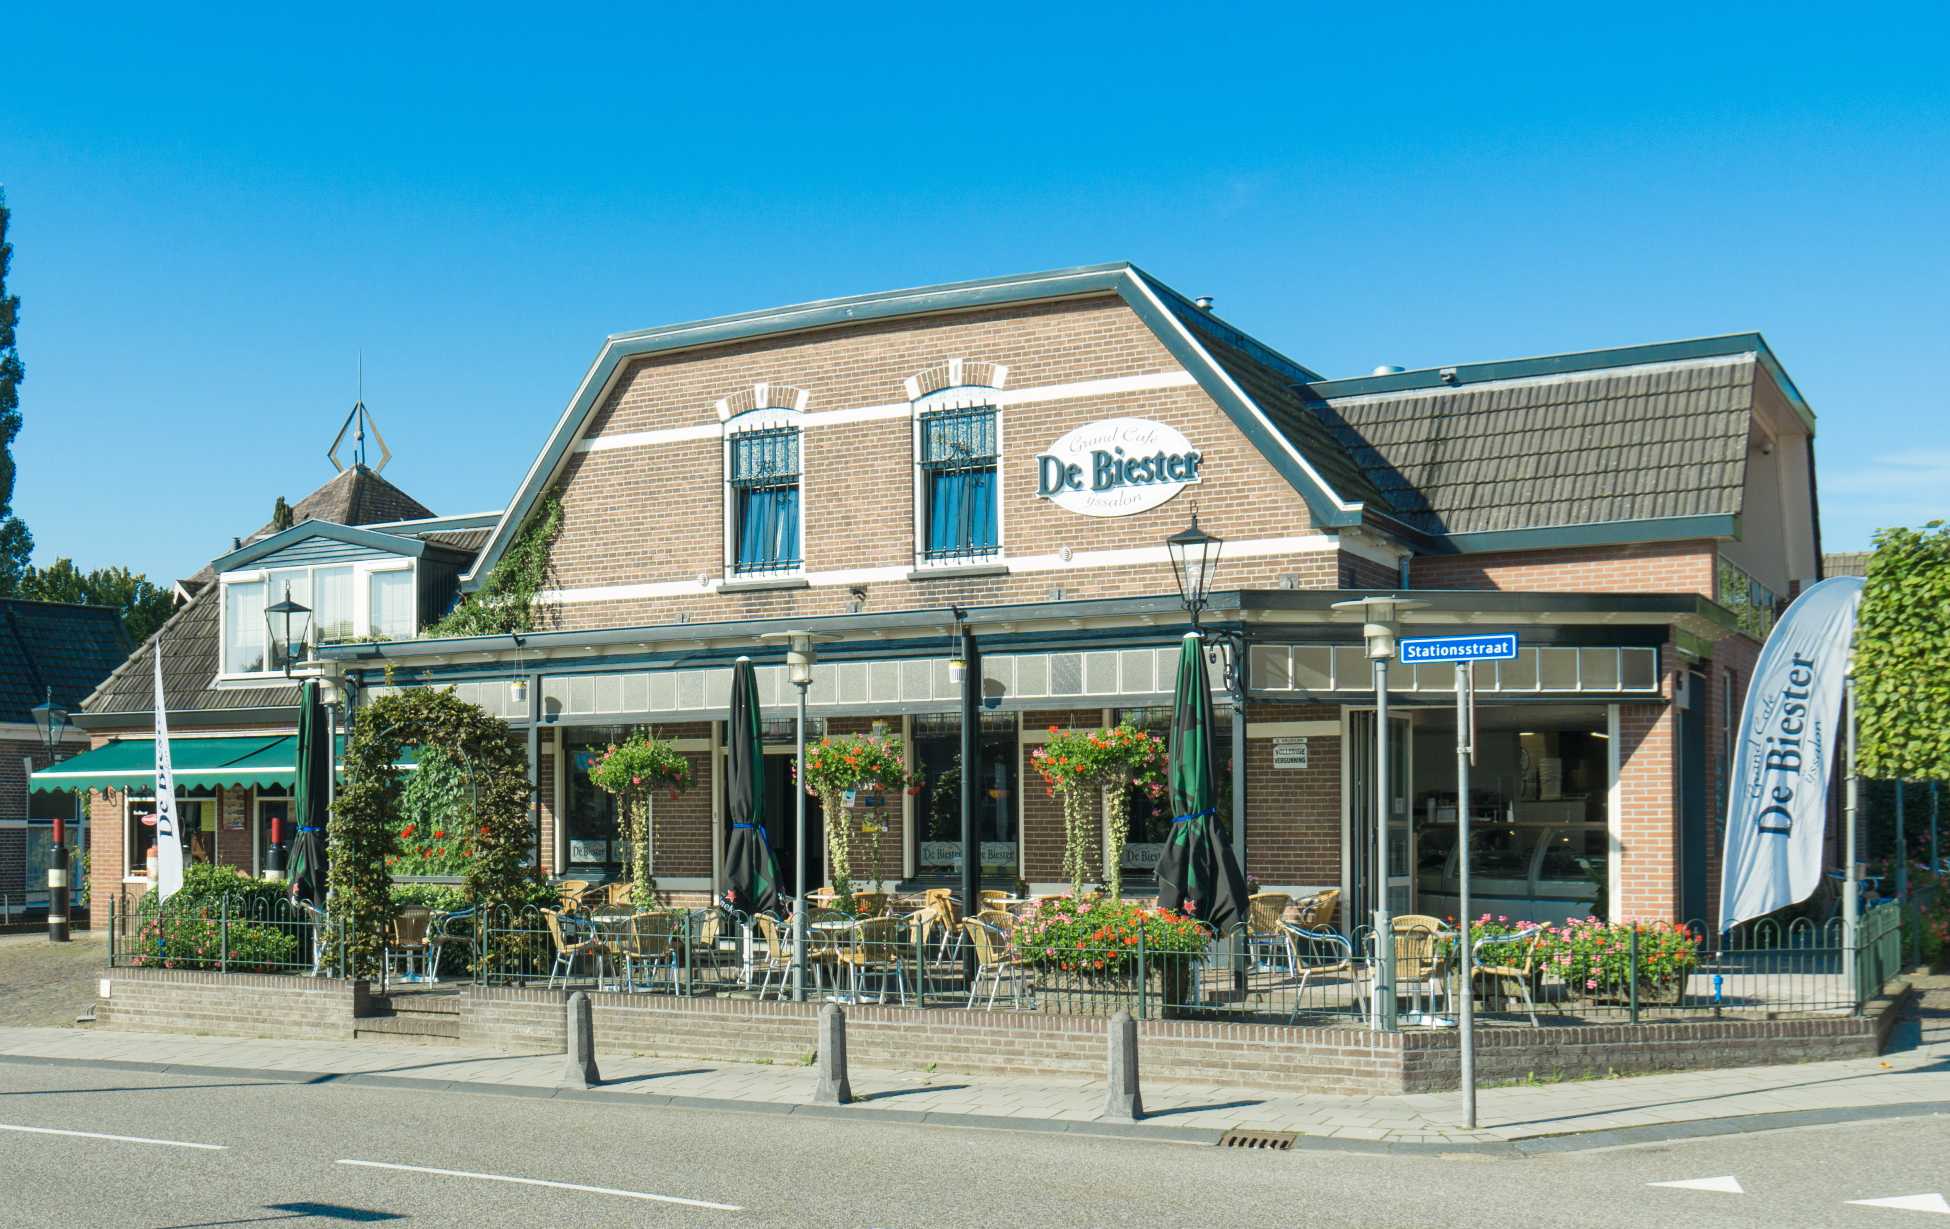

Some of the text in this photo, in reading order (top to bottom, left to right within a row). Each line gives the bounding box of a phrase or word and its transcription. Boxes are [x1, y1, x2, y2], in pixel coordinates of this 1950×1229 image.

[1070, 426, 1119, 453] Grand
[1037, 446, 1204, 496] De Biester
[1407, 642, 1508, 658] Stationsstraat
[1758, 652, 1815, 838] De Biester
[159, 800, 173, 837] De
